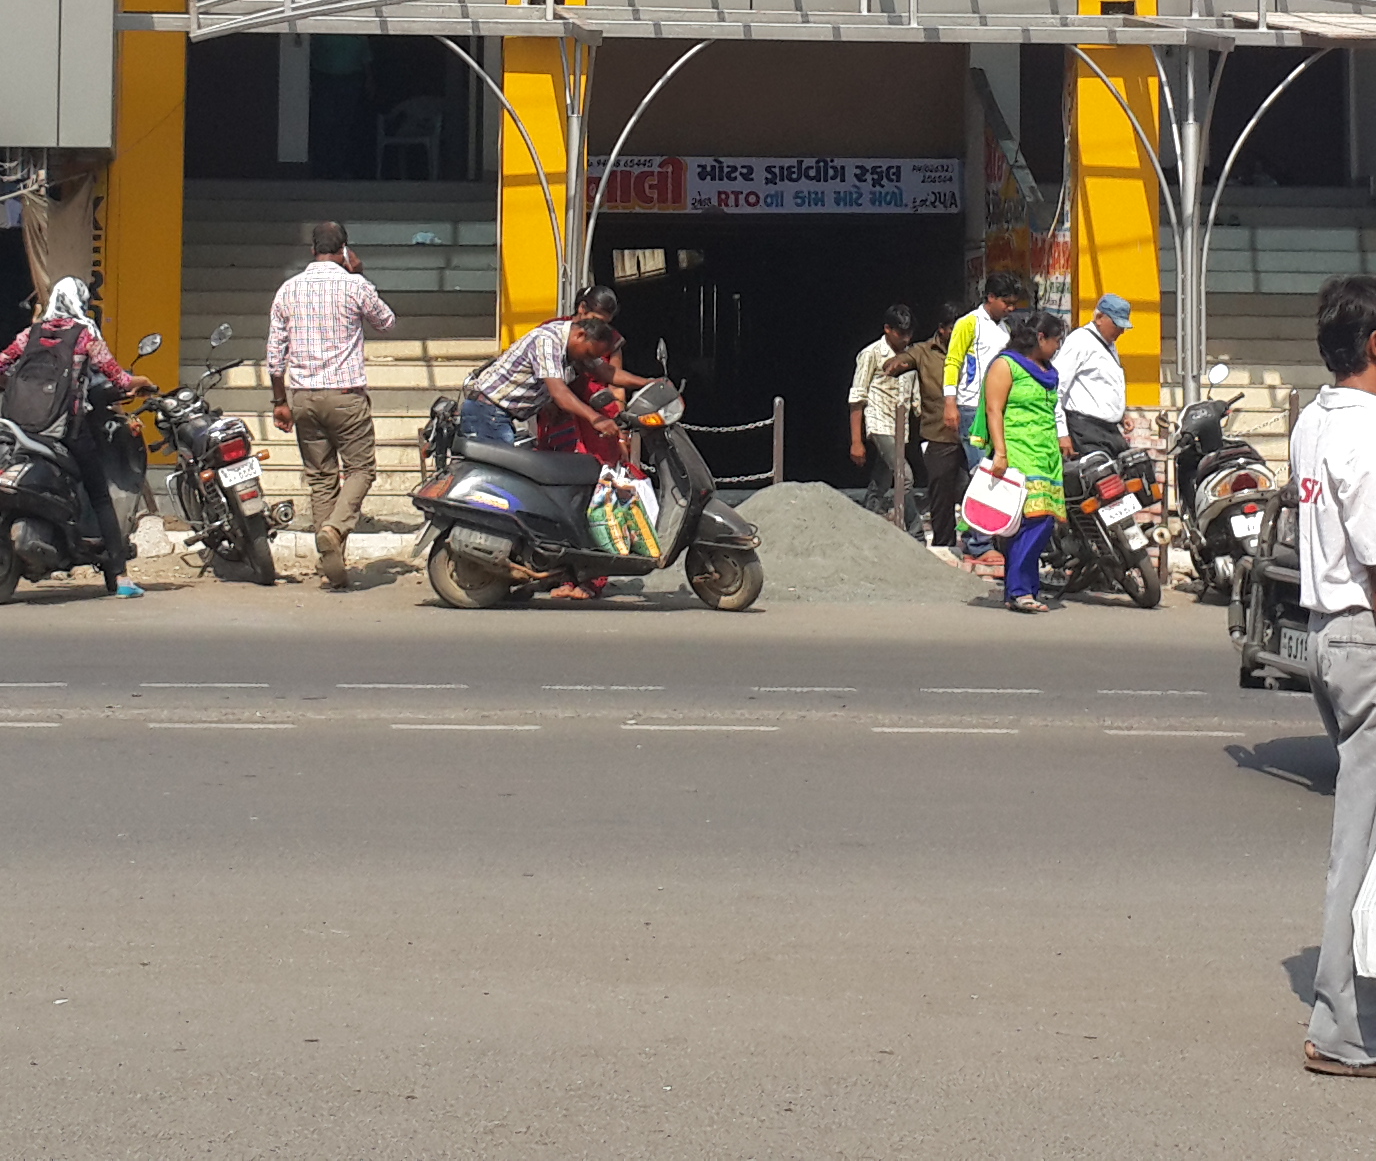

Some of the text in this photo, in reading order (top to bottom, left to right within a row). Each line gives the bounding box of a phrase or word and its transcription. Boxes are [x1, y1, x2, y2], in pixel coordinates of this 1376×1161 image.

[696, 158, 755, 182] મોટર
[792, 190, 826, 208] કામ
[833, 184, 864, 208] માટે
